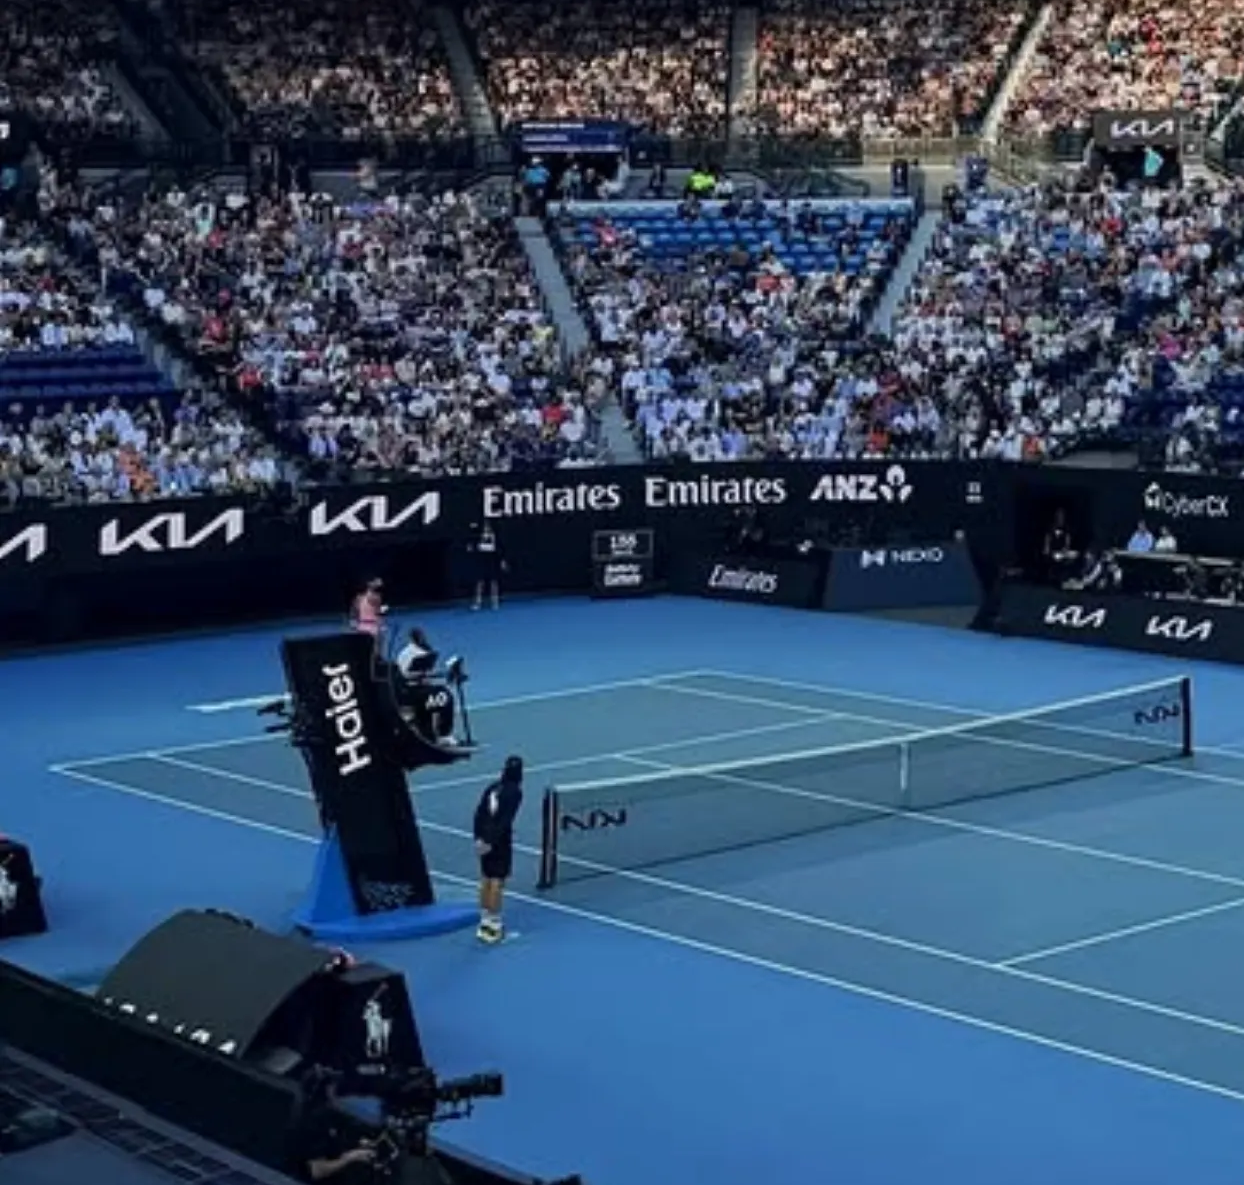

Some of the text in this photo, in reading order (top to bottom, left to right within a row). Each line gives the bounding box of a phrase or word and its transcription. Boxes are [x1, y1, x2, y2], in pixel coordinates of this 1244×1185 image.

[1111, 118, 1175, 138] KIA
[100, 473, 878, 555] KIA KIA Emirates Emirates ANZ
[1162, 495, 1229, 518] CyberCX
[708, 564, 778, 593] Emirates
[1045, 605, 1106, 628] KIA
[1146, 616, 1213, 641] KIA
[321, 662, 372, 777] Haier
